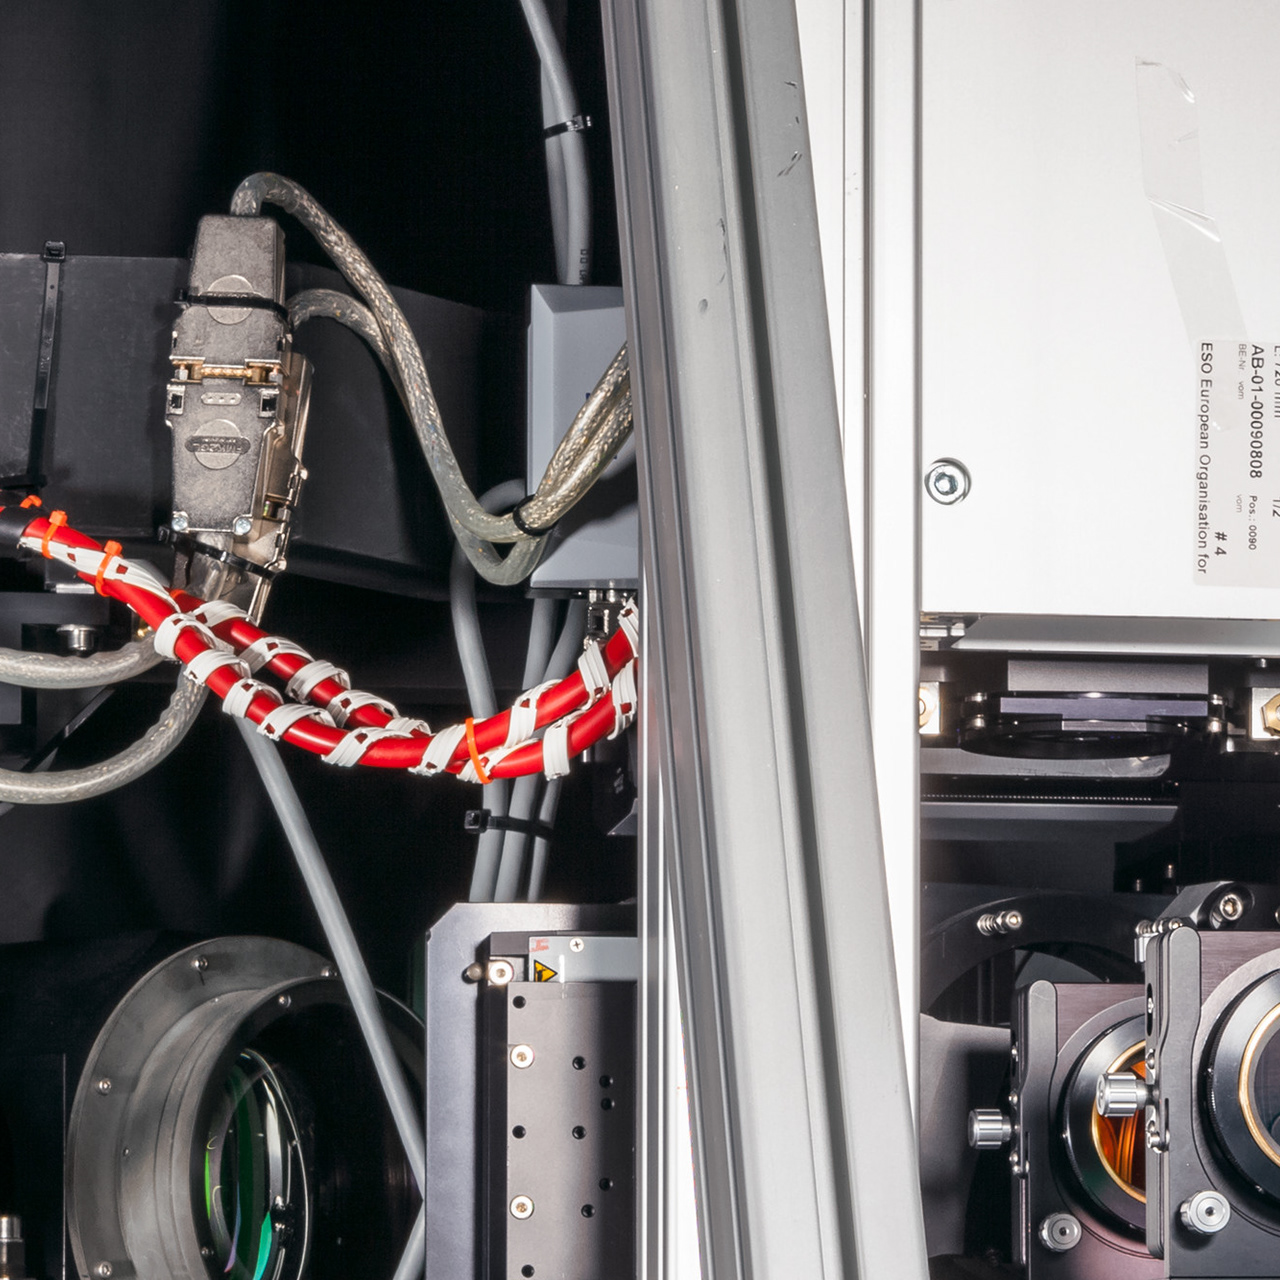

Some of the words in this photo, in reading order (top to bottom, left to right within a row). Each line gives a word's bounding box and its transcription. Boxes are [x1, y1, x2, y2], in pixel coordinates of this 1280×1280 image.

[1201, 342, 1213, 374] ESO
[1198, 379, 1212, 449] European
[1249, 344, 1265, 479] AB-01-00090808
[1196, 454, 1211, 549] Organisation
[1248, 495, 1257, 522] Pos.:
[1214, 531, 1228, 541] #
[1248, 524, 1257, 550] 0090
[1197, 554, 1210, 574] for
[1214, 547, 1227, 556] 4
